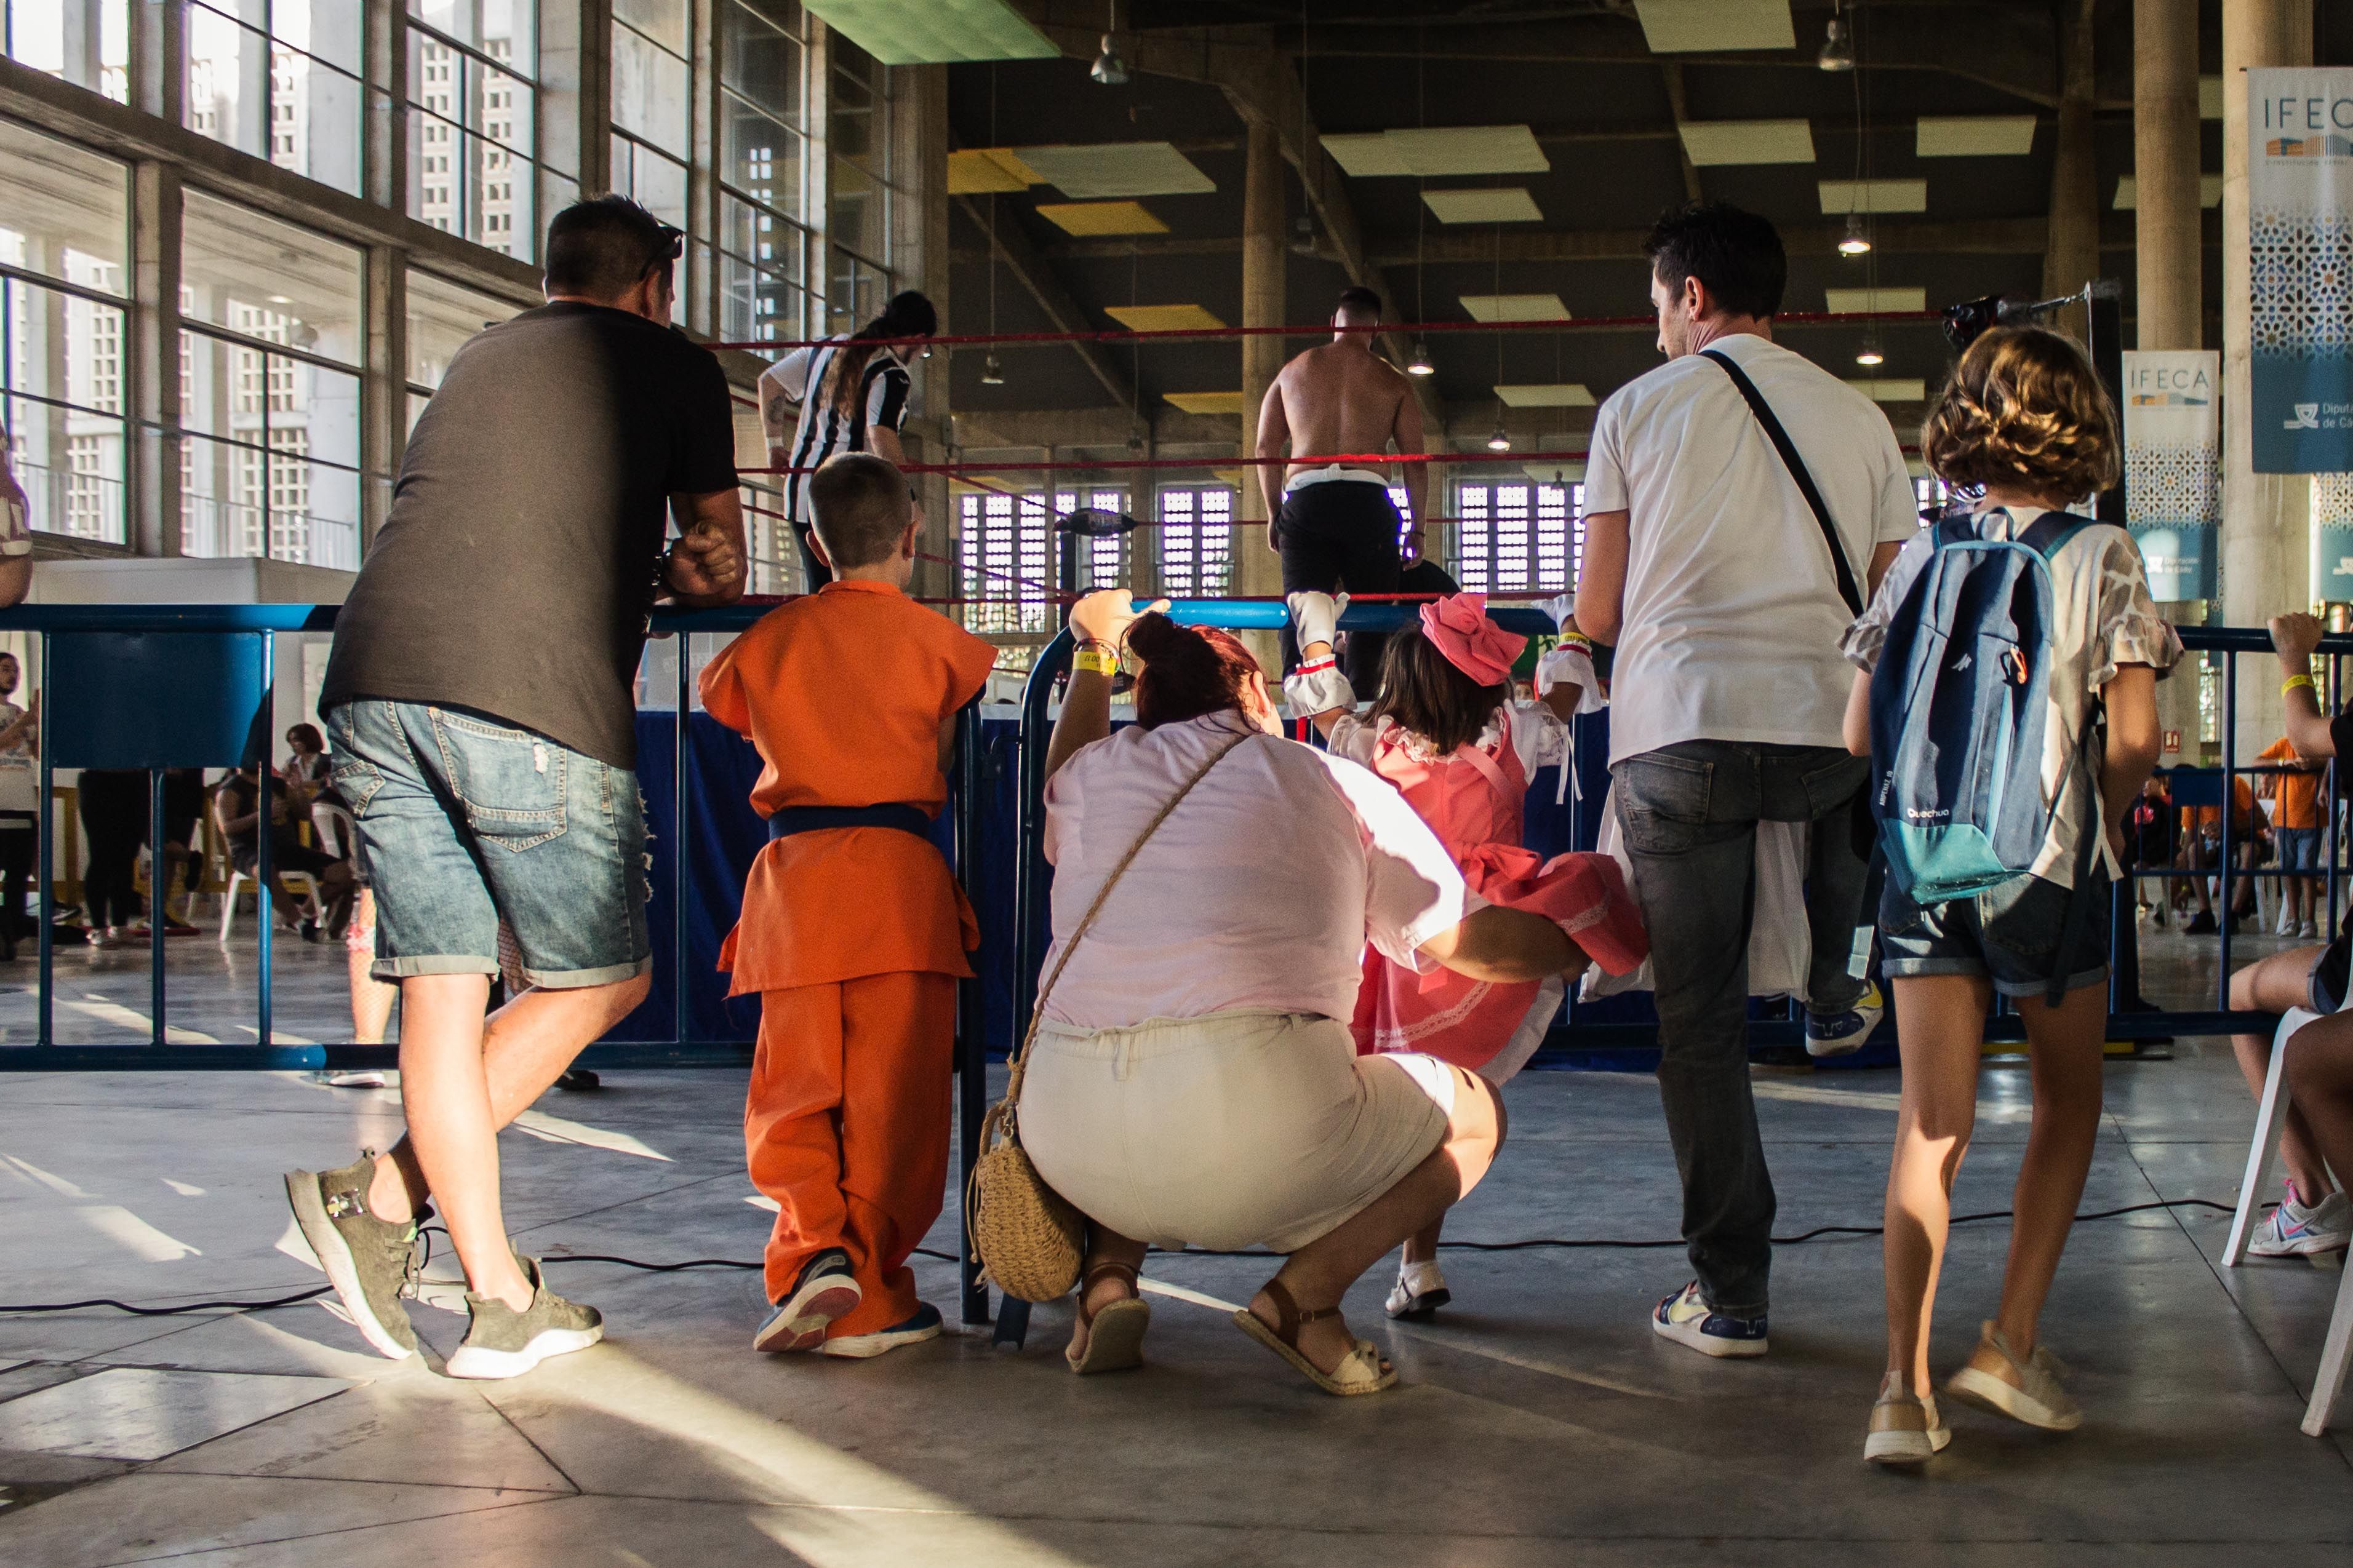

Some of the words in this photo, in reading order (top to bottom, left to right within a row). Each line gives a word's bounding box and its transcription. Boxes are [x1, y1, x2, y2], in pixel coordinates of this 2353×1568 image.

[2131, 369, 2208, 389] IFECA
[2323, 418, 2336, 429] de
[1908, 808, 1949, 818] Quechua
